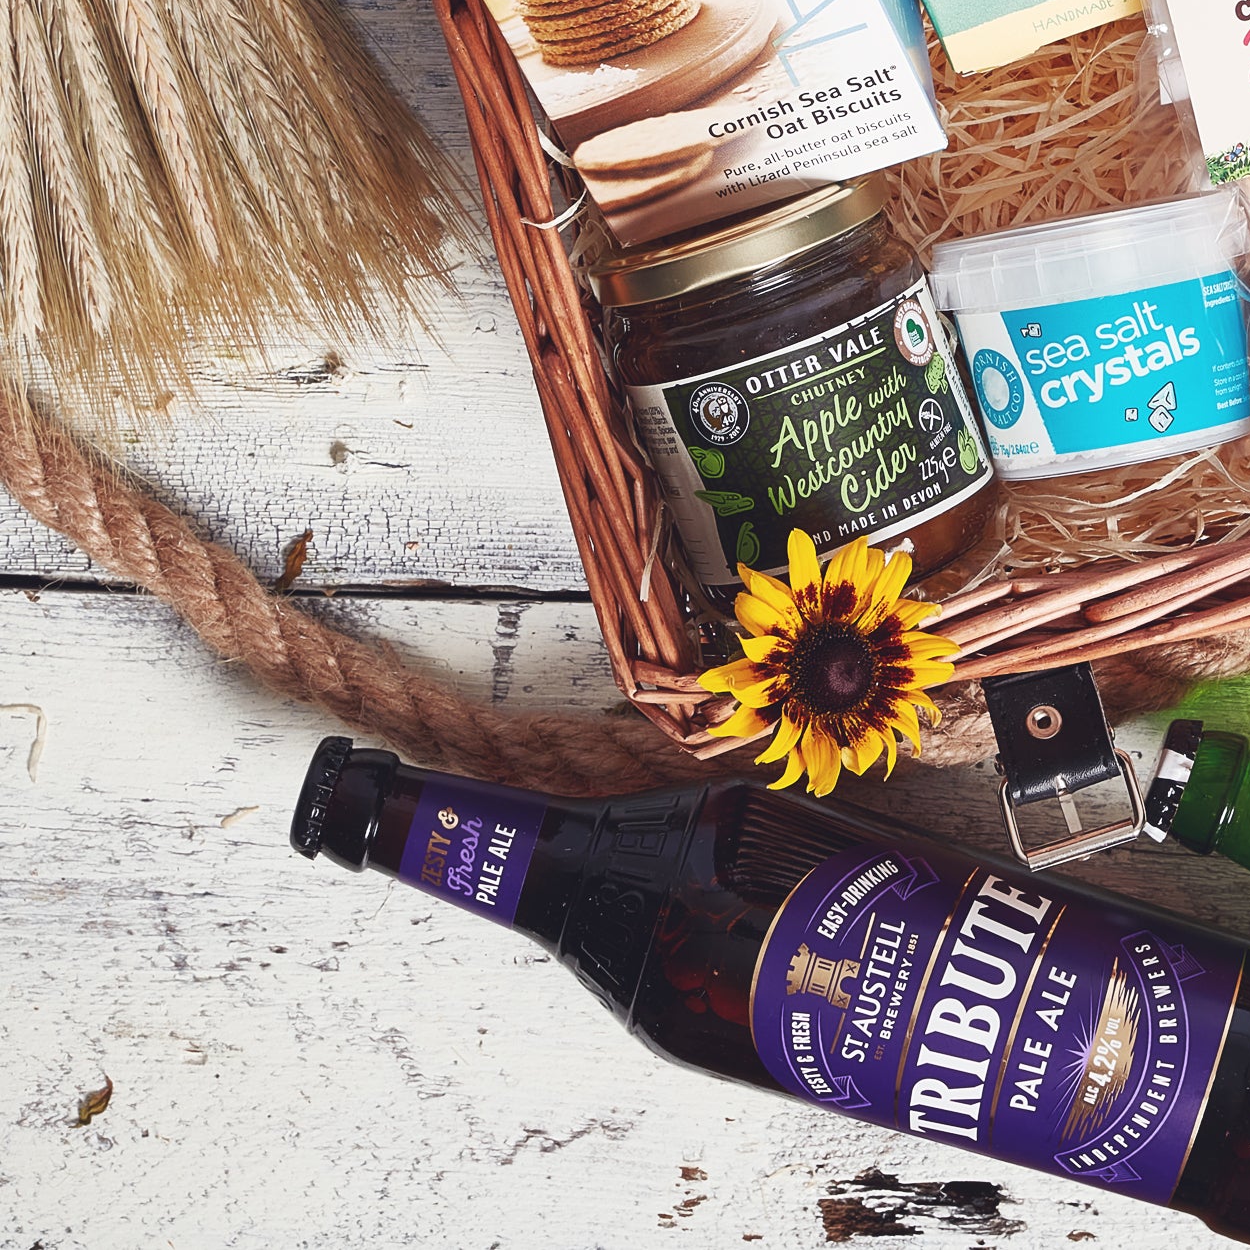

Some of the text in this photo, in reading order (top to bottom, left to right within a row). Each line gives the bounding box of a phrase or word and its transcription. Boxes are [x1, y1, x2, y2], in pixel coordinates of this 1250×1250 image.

[708, 100, 795, 139] Cornish
[798, 86, 842, 108] Sea
[723, 111, 912, 180] Pure, all-butter oat biscuits
[766, 88, 902, 140] Oat Biscuits
[714, 124, 918, 199] with Lizard Peninsula sea salt
[745, 354, 822, 394] OTTER
[828, 326, 884, 363] VALE
[974, 352, 1017, 384] CORNISH
[1025, 300, 1164, 375] sea salt
[1040, 324, 1201, 409] crystals
[770, 392, 862, 469] Apple
[868, 366, 907, 409] with
[790, 366, 865, 406] CHUTNEY
[768, 397, 913, 517] Westcountry
[841, 441, 917, 513] Cider
[839, 482, 942, 537] MADE IN DEVON
[420, 806, 459, 887] ZESTY &
[447, 816, 484, 896] Fresh
[475, 823, 517, 905] PALE ALE
[817, 859, 899, 940] EASY-DRINKING
[852, 919, 907, 1039] AUSTELL
[879, 933, 919, 1040] BREWERY 1851
[909, 874, 1053, 1143] TRIBUTE
[790, 1011, 833, 1095] ZESTY & FRESH
[1009, 965, 1077, 1112] PALE ALE
[1069, 943, 1178, 1169] INDEPENDENT BREWERS
[1083, 1016, 1122, 1106] ALC 4.2% VOL
